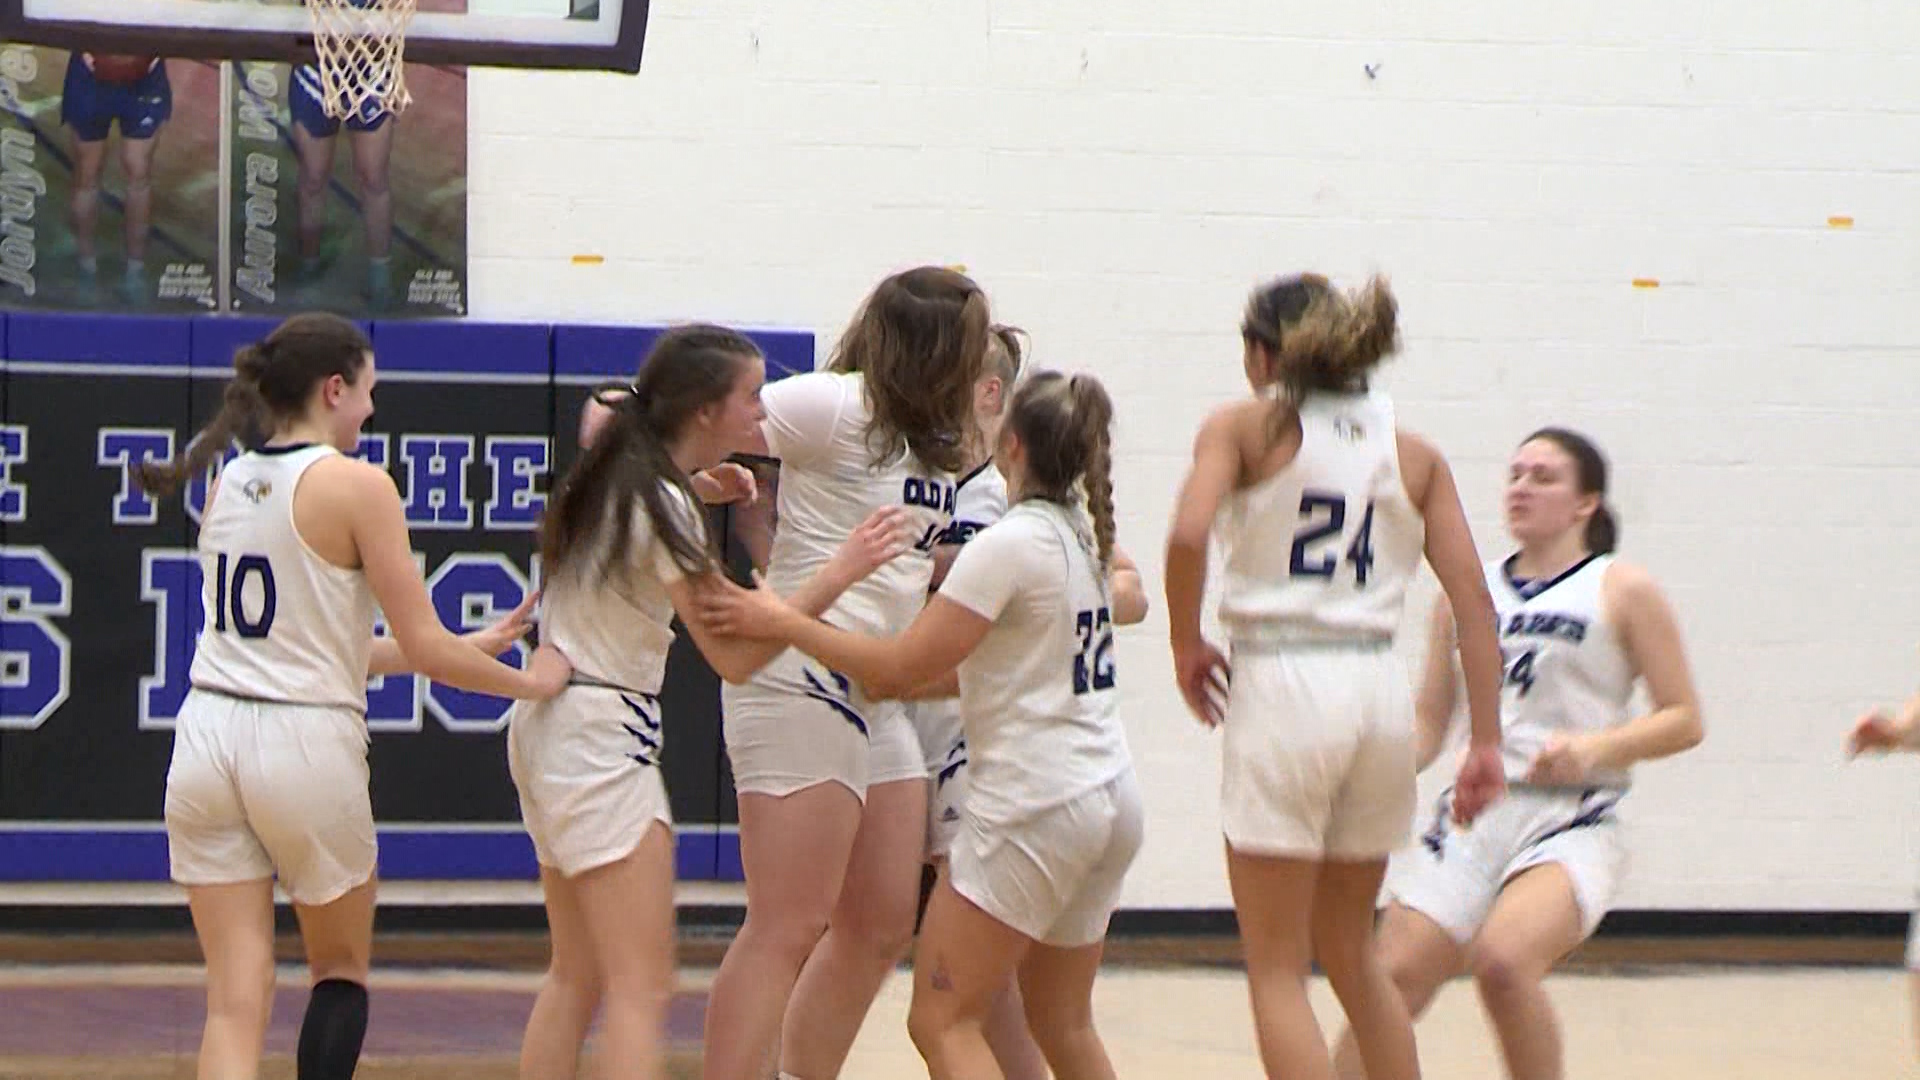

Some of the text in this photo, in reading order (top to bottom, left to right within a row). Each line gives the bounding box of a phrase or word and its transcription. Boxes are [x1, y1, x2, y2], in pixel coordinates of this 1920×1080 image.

[236, 61, 279, 303] Aurora Wo
[904, 477, 940, 509] OLD
[1290, 490, 1374, 585] 24
[216, 552, 276, 638] 10
